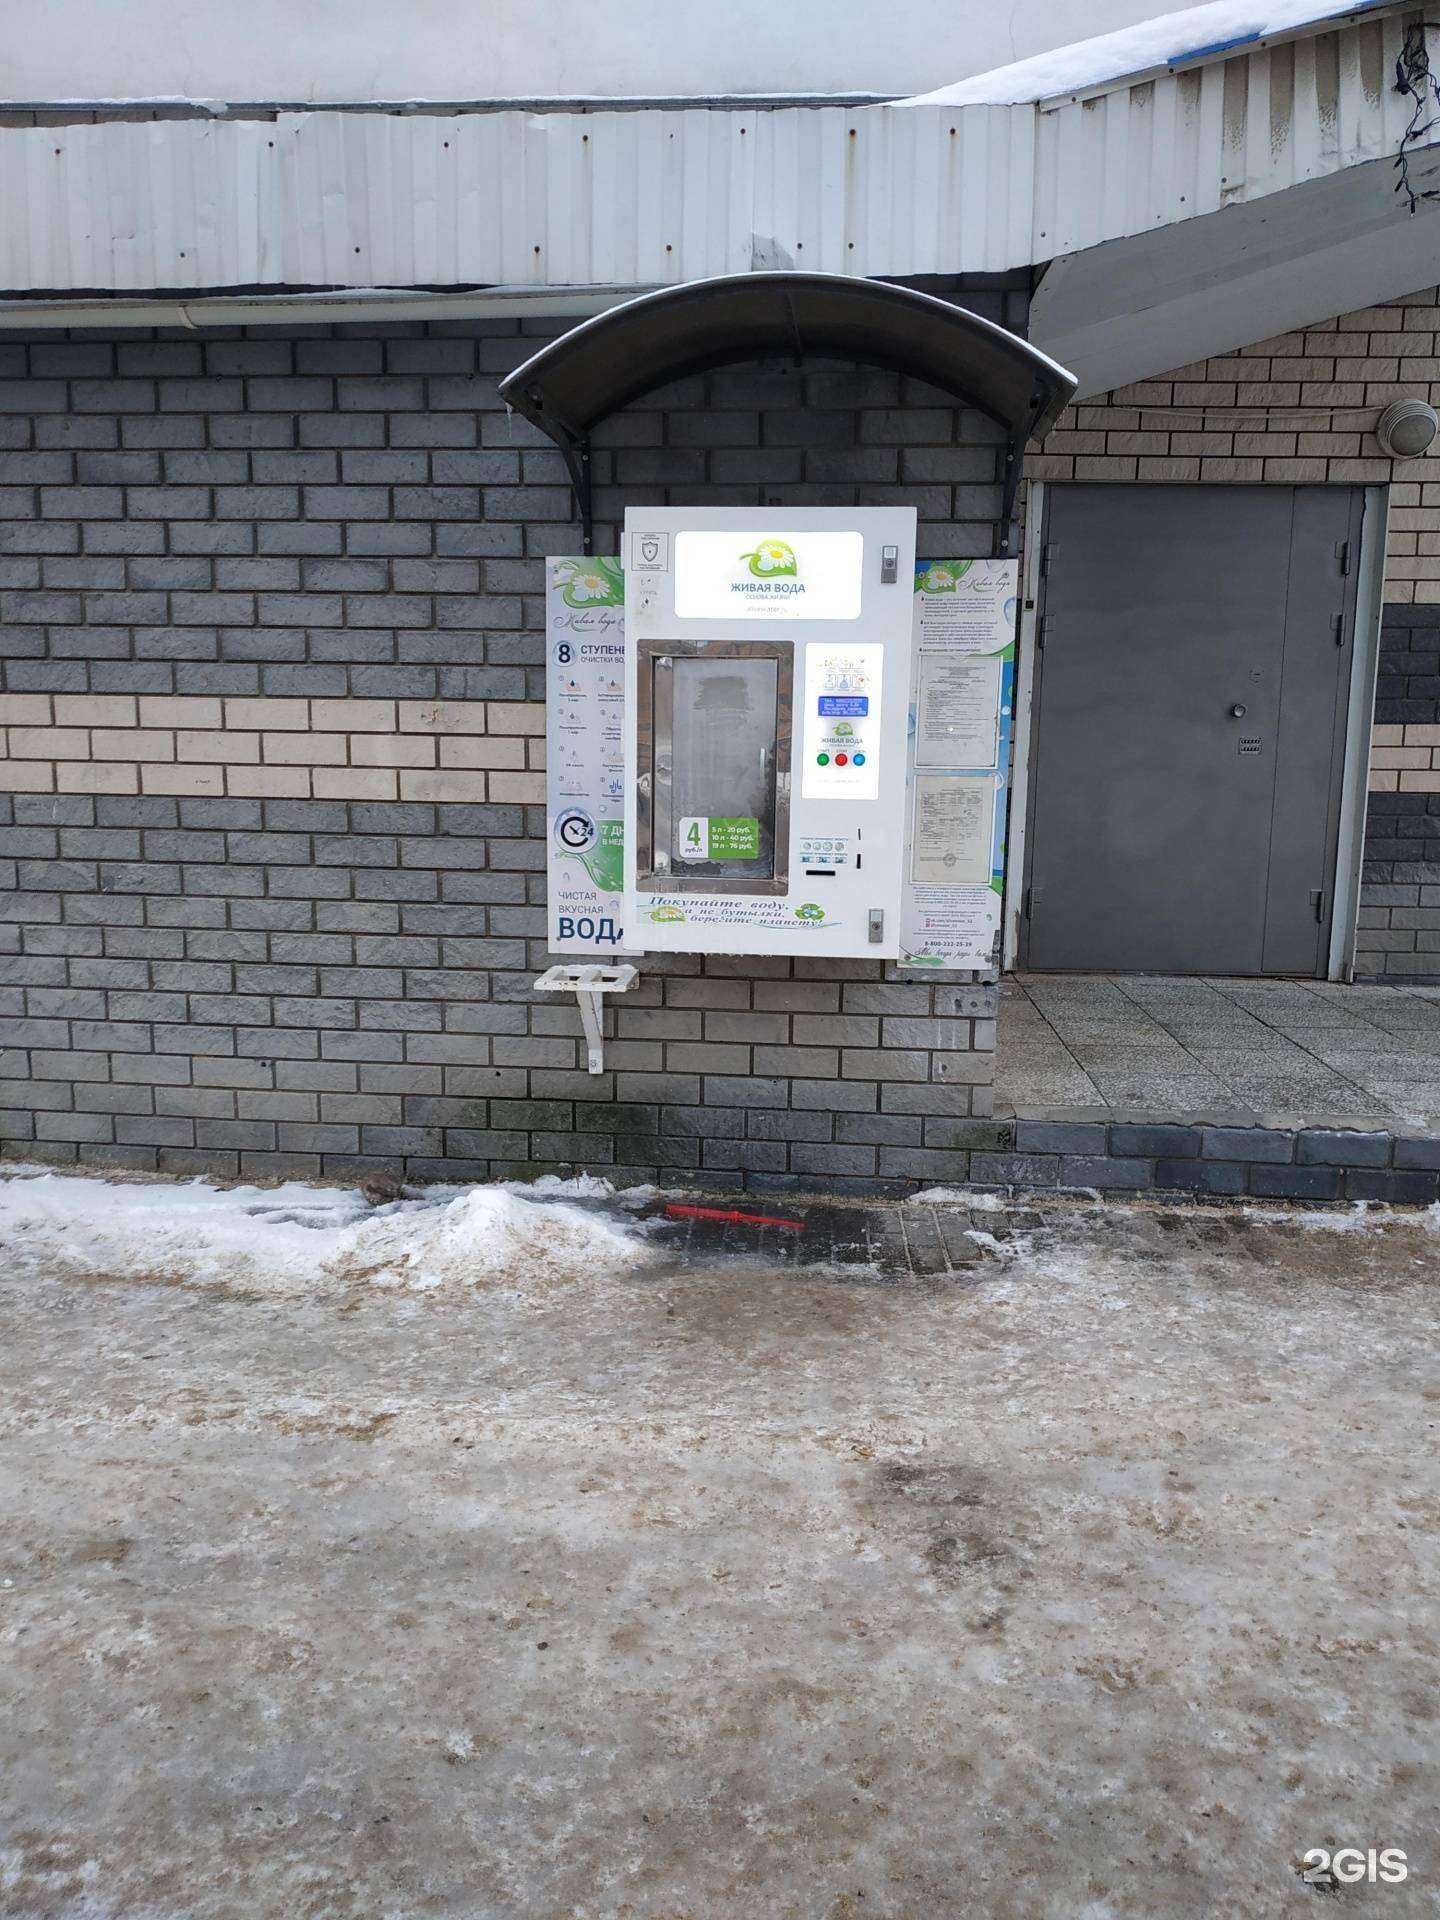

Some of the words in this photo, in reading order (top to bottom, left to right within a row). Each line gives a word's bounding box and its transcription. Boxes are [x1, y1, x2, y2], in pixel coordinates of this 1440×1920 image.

[730, 583, 771, 592] ЖИВАЯ
[774, 583, 806, 594] ВОДА
[558, 644, 571, 663] 8
[580, 656, 612, 664] ОЧИСТКИ
[614, 656, 625, 664] ВО
[580, 827, 594, 837] 24
[601, 825, 608, 835] 7
[687, 822, 701, 846] 4
[558, 891, 597, 900] ЧИСТАЯ
[650, 896, 742, 908] Покупайте
[558, 904, 604, 914] ВКУСНАЯ
